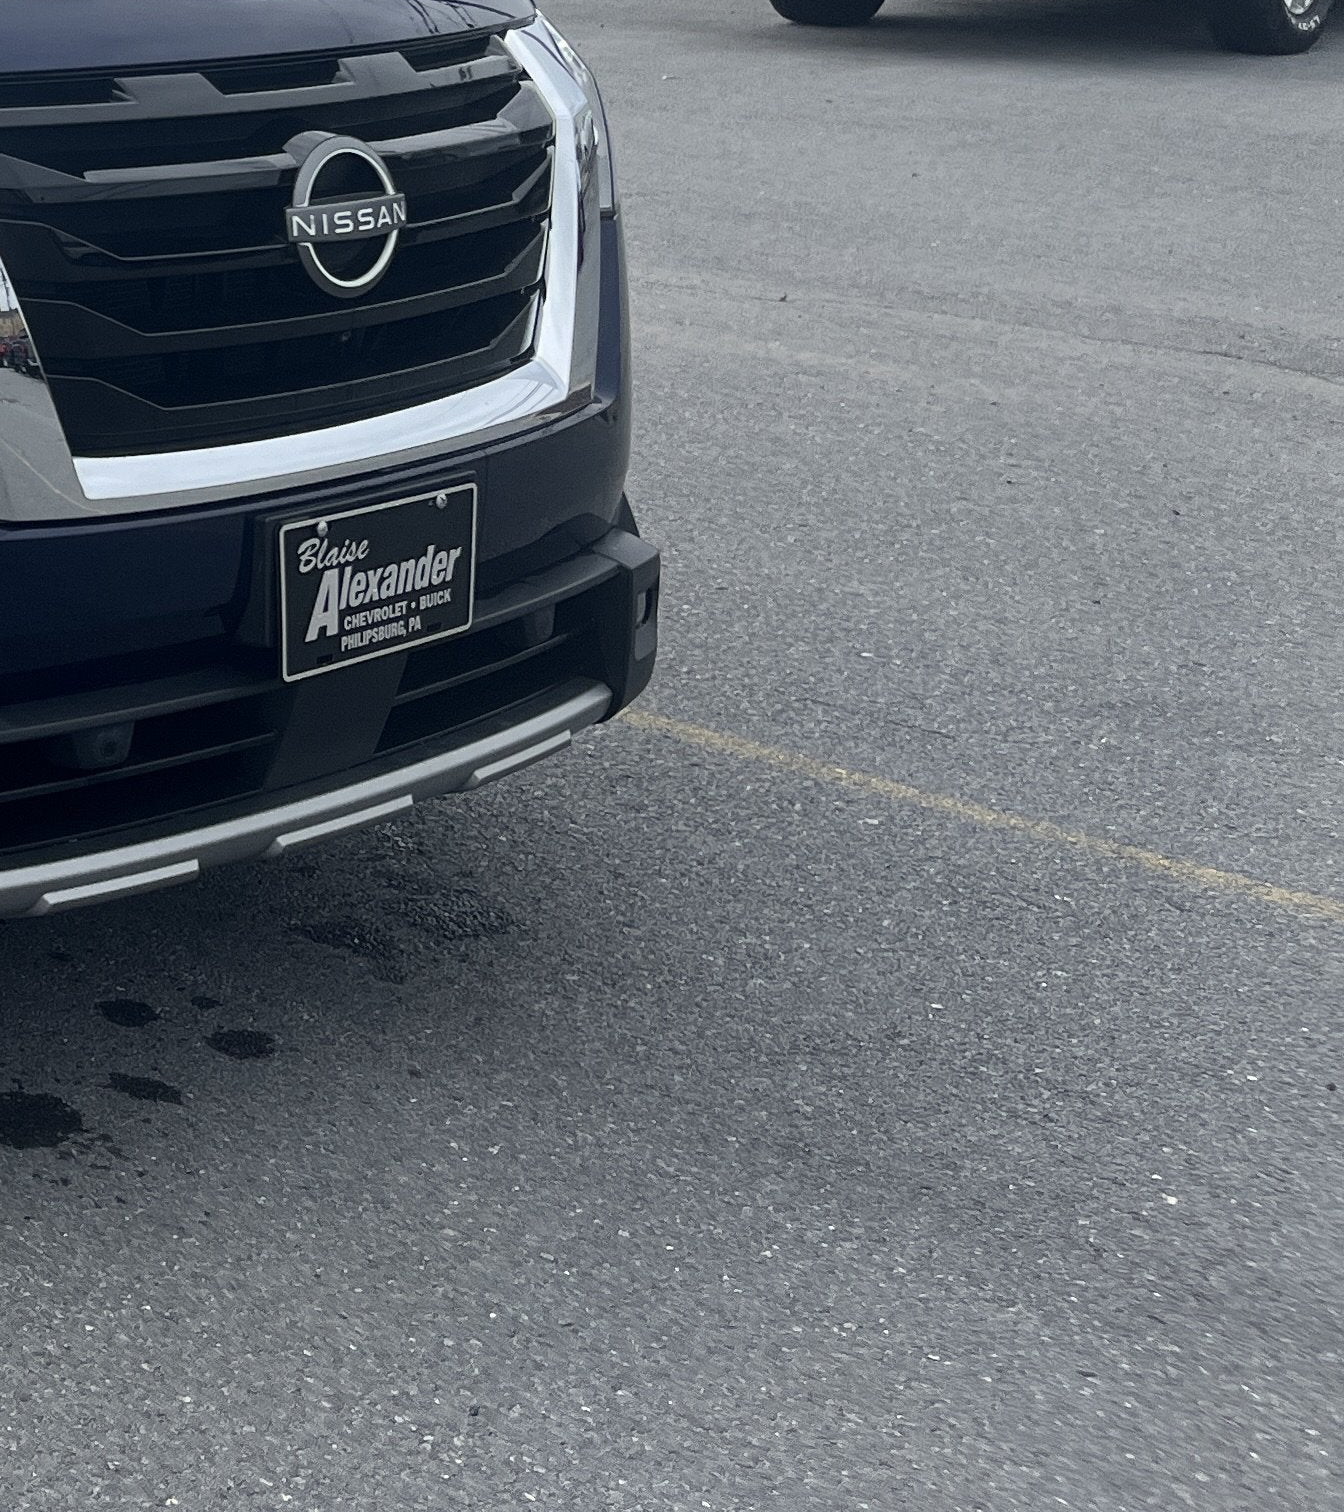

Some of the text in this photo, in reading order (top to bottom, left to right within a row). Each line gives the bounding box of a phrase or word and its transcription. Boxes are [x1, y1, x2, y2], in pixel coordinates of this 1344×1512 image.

[291, 200, 407, 237] NISSAN
[297, 538, 369, 573] Blaise
[305, 544, 462, 643] Alexander
[344, 588, 451, 630] CHEVROLET BUICK
[409, 615, 422, 632] PA
